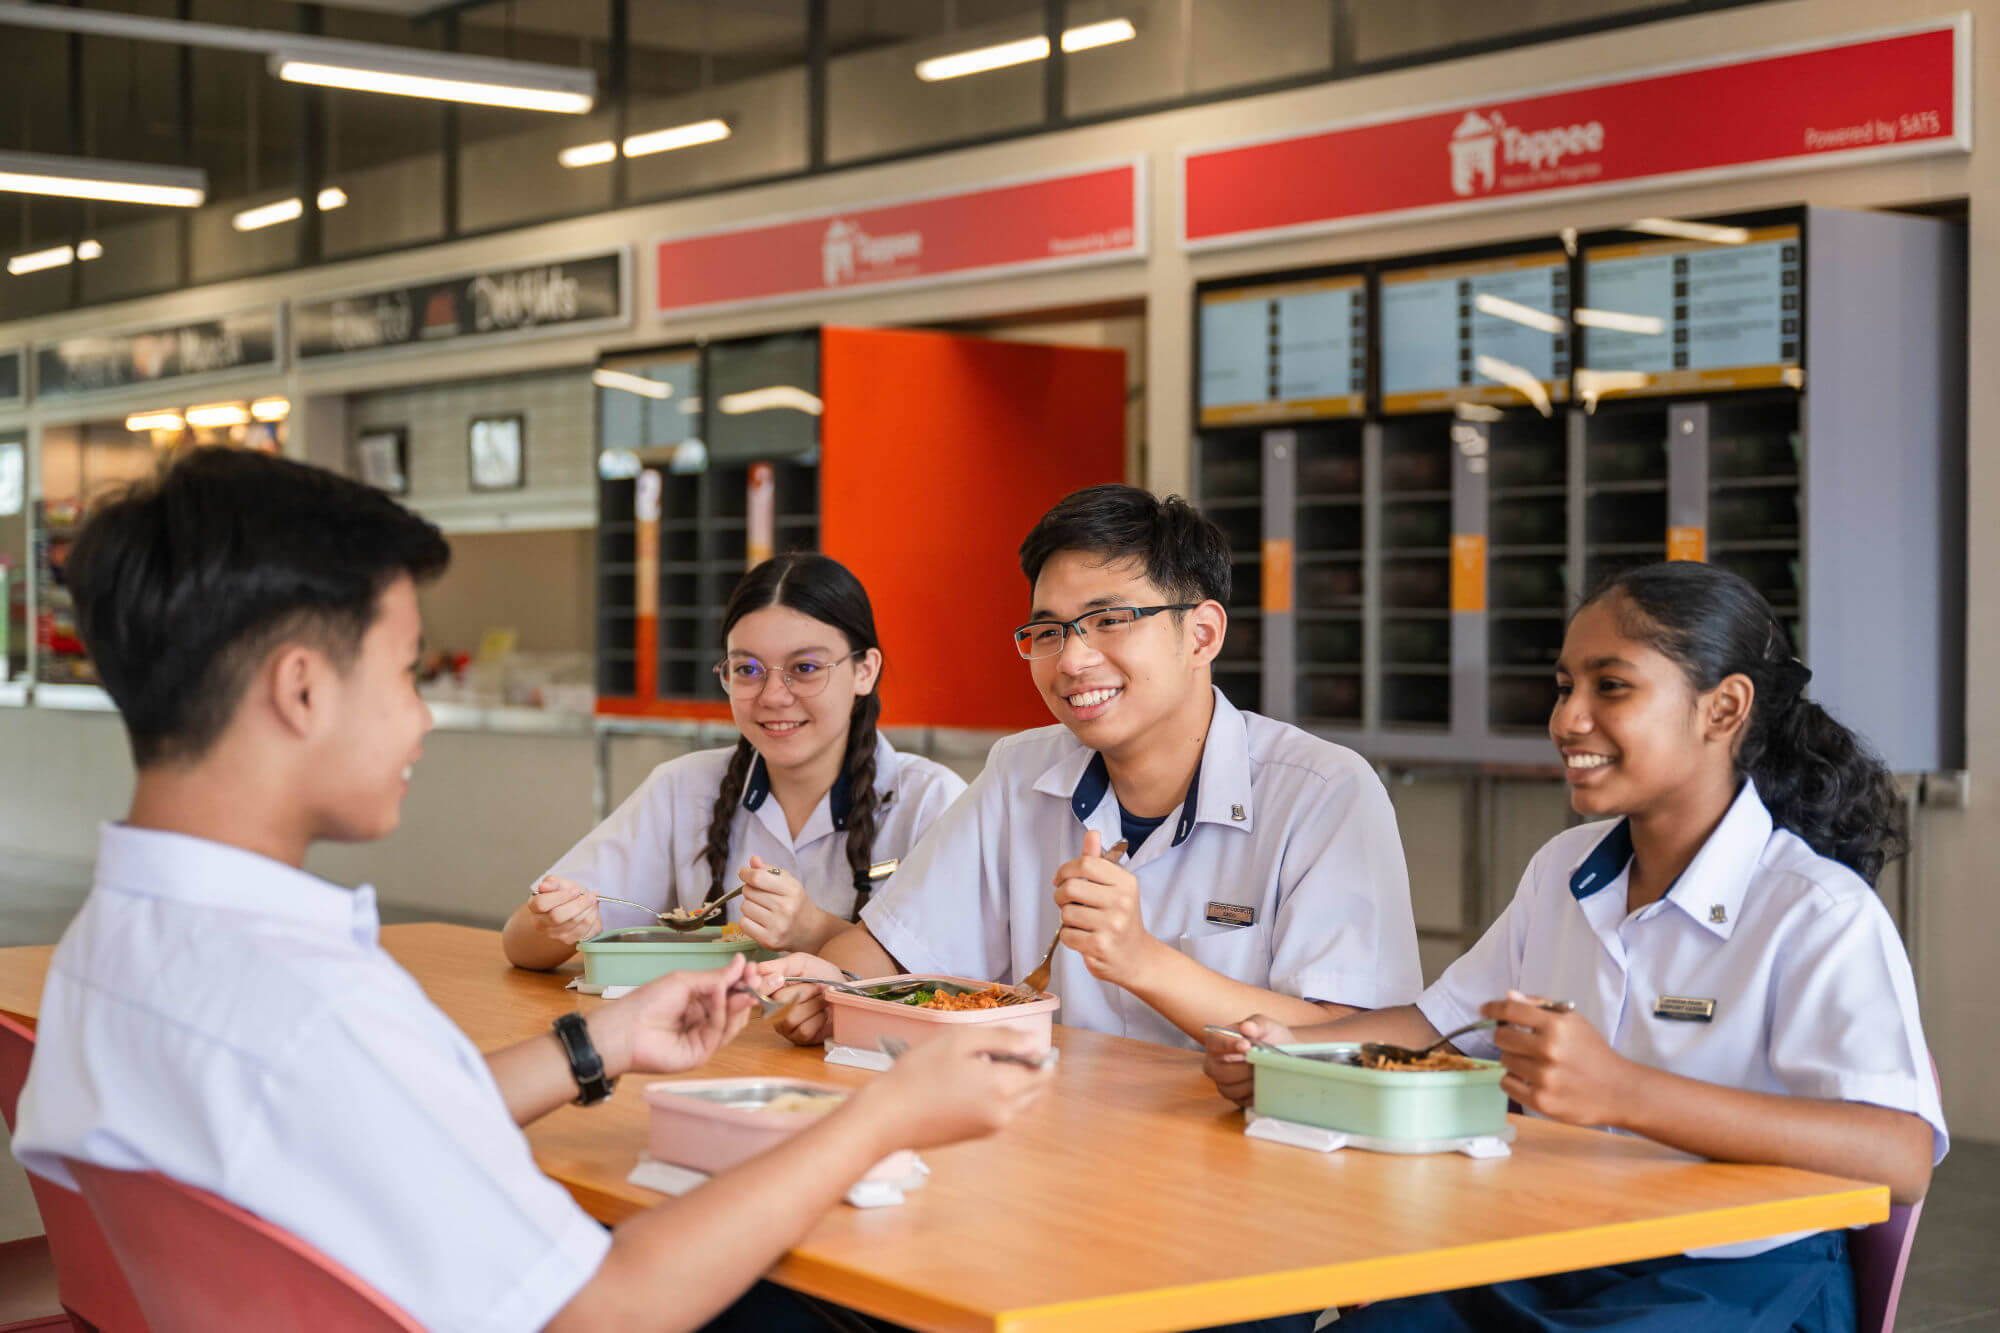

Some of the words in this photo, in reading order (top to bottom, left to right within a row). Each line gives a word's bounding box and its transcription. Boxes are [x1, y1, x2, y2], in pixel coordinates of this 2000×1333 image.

[1502, 122, 1604, 169] Tappee
[1804, 119, 1873, 149] Powered
[1875, 117, 1898, 142] by
[1900, 110, 1940, 137] SATS
